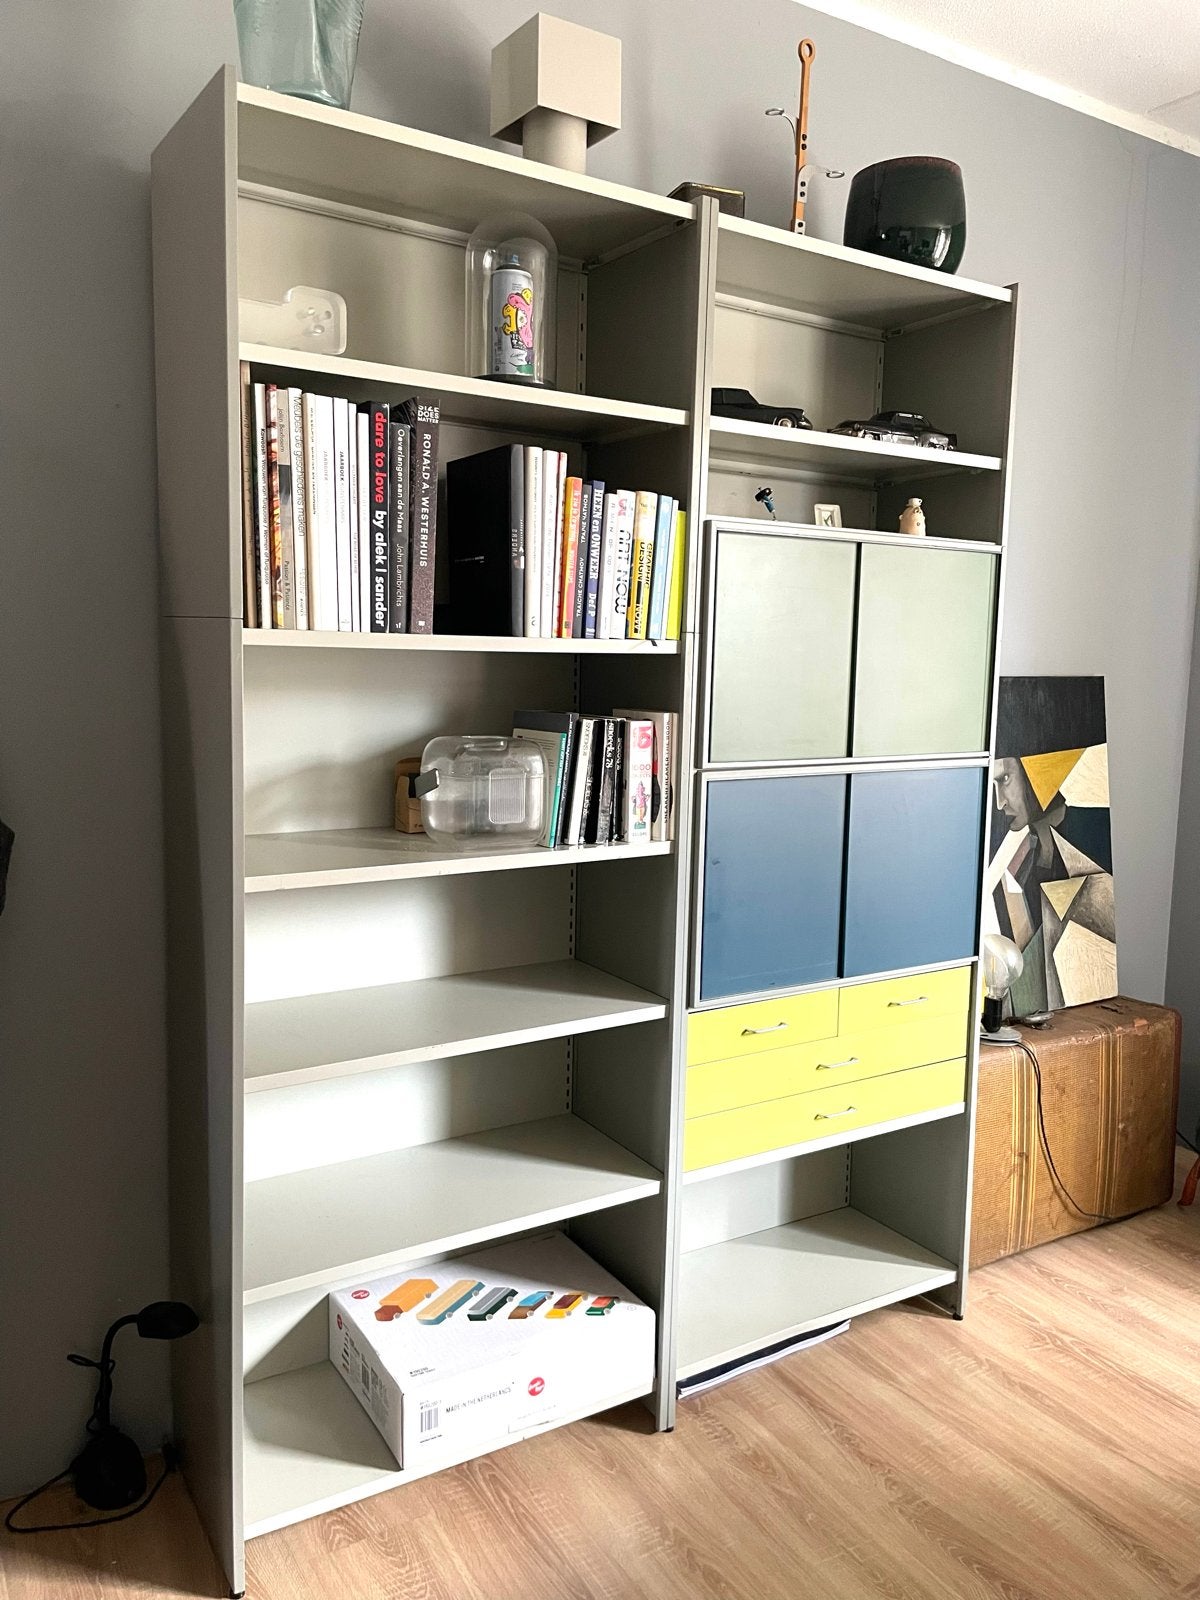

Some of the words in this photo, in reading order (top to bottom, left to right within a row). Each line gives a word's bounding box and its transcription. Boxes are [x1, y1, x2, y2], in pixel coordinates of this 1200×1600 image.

[375, 412, 387, 448] dare
[418, 410, 440, 419] DOES
[375, 452, 386, 468] to
[396, 429, 405, 482] Oeverlangen
[422, 434, 432, 480] RONALD
[294, 450, 306, 505] geschiedenis
[375, 472, 387, 504] love
[421, 482, 430, 494] A.
[372, 510, 387, 529] by
[398, 500, 404, 510] de
[593, 489, 604, 519] HEEN
[298, 508, 307, 537] maken
[420, 496, 430, 567] WESTERHUIS
[592, 520, 600, 532] en
[375, 532, 387, 565] alek
[396, 544, 404, 562] John
[590, 534, 601, 580] ONWEER
[638, 542, 646, 582] DESIGN
[645, 543, 653, 587] GRAPHIC
[375, 576, 387, 627] sander
[396, 564, 404, 607] Lambrichts
[588, 592, 596, 609] Def
[615, 570, 628, 614] NOW
[588, 610, 596, 618] P
